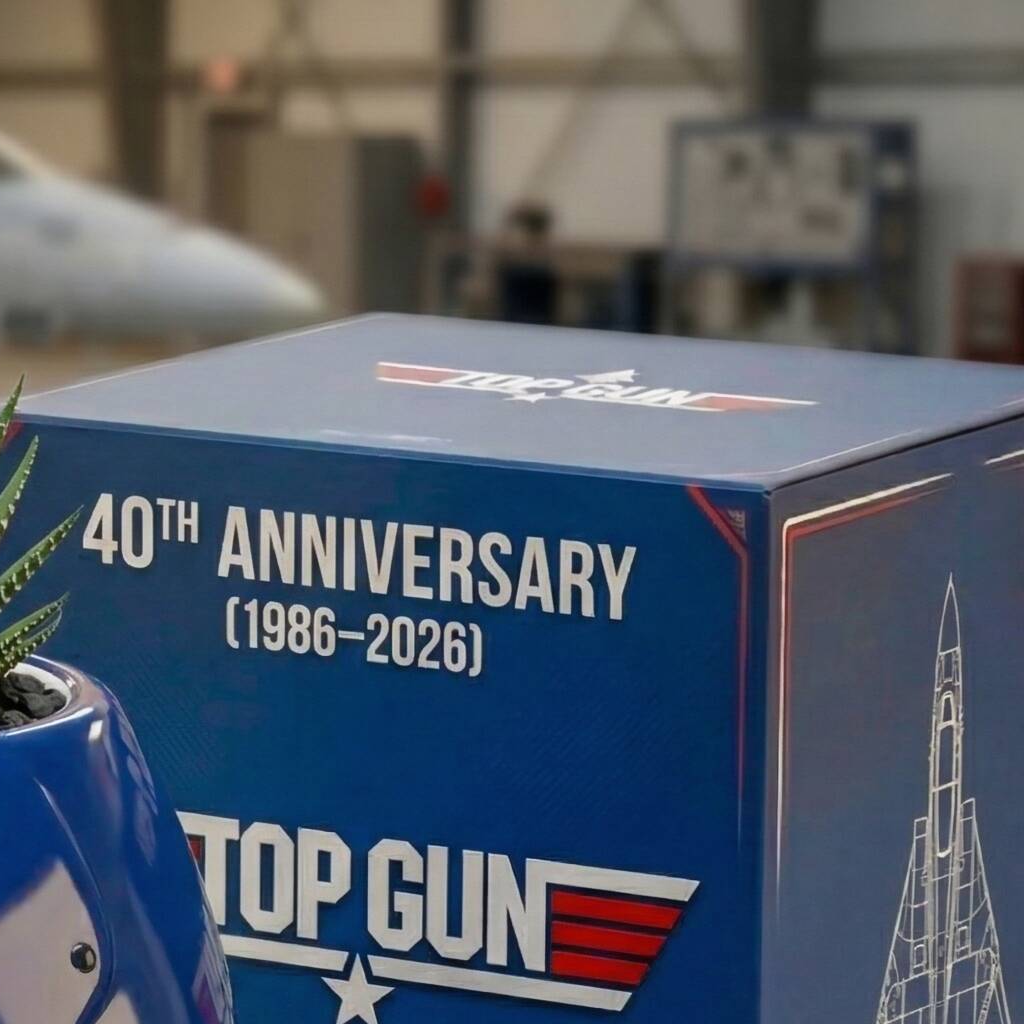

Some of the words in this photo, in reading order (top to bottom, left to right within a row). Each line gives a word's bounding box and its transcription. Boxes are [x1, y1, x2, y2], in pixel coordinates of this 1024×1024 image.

[441, 370, 575, 394] TOP
[560, 383, 708, 405] GUN
[82, 492, 200, 569] 40TH
[217, 505, 637, 621] ANNIVERSARY
[176, 810, 352, 940] TOP
[367, 838, 547, 972] GUN
